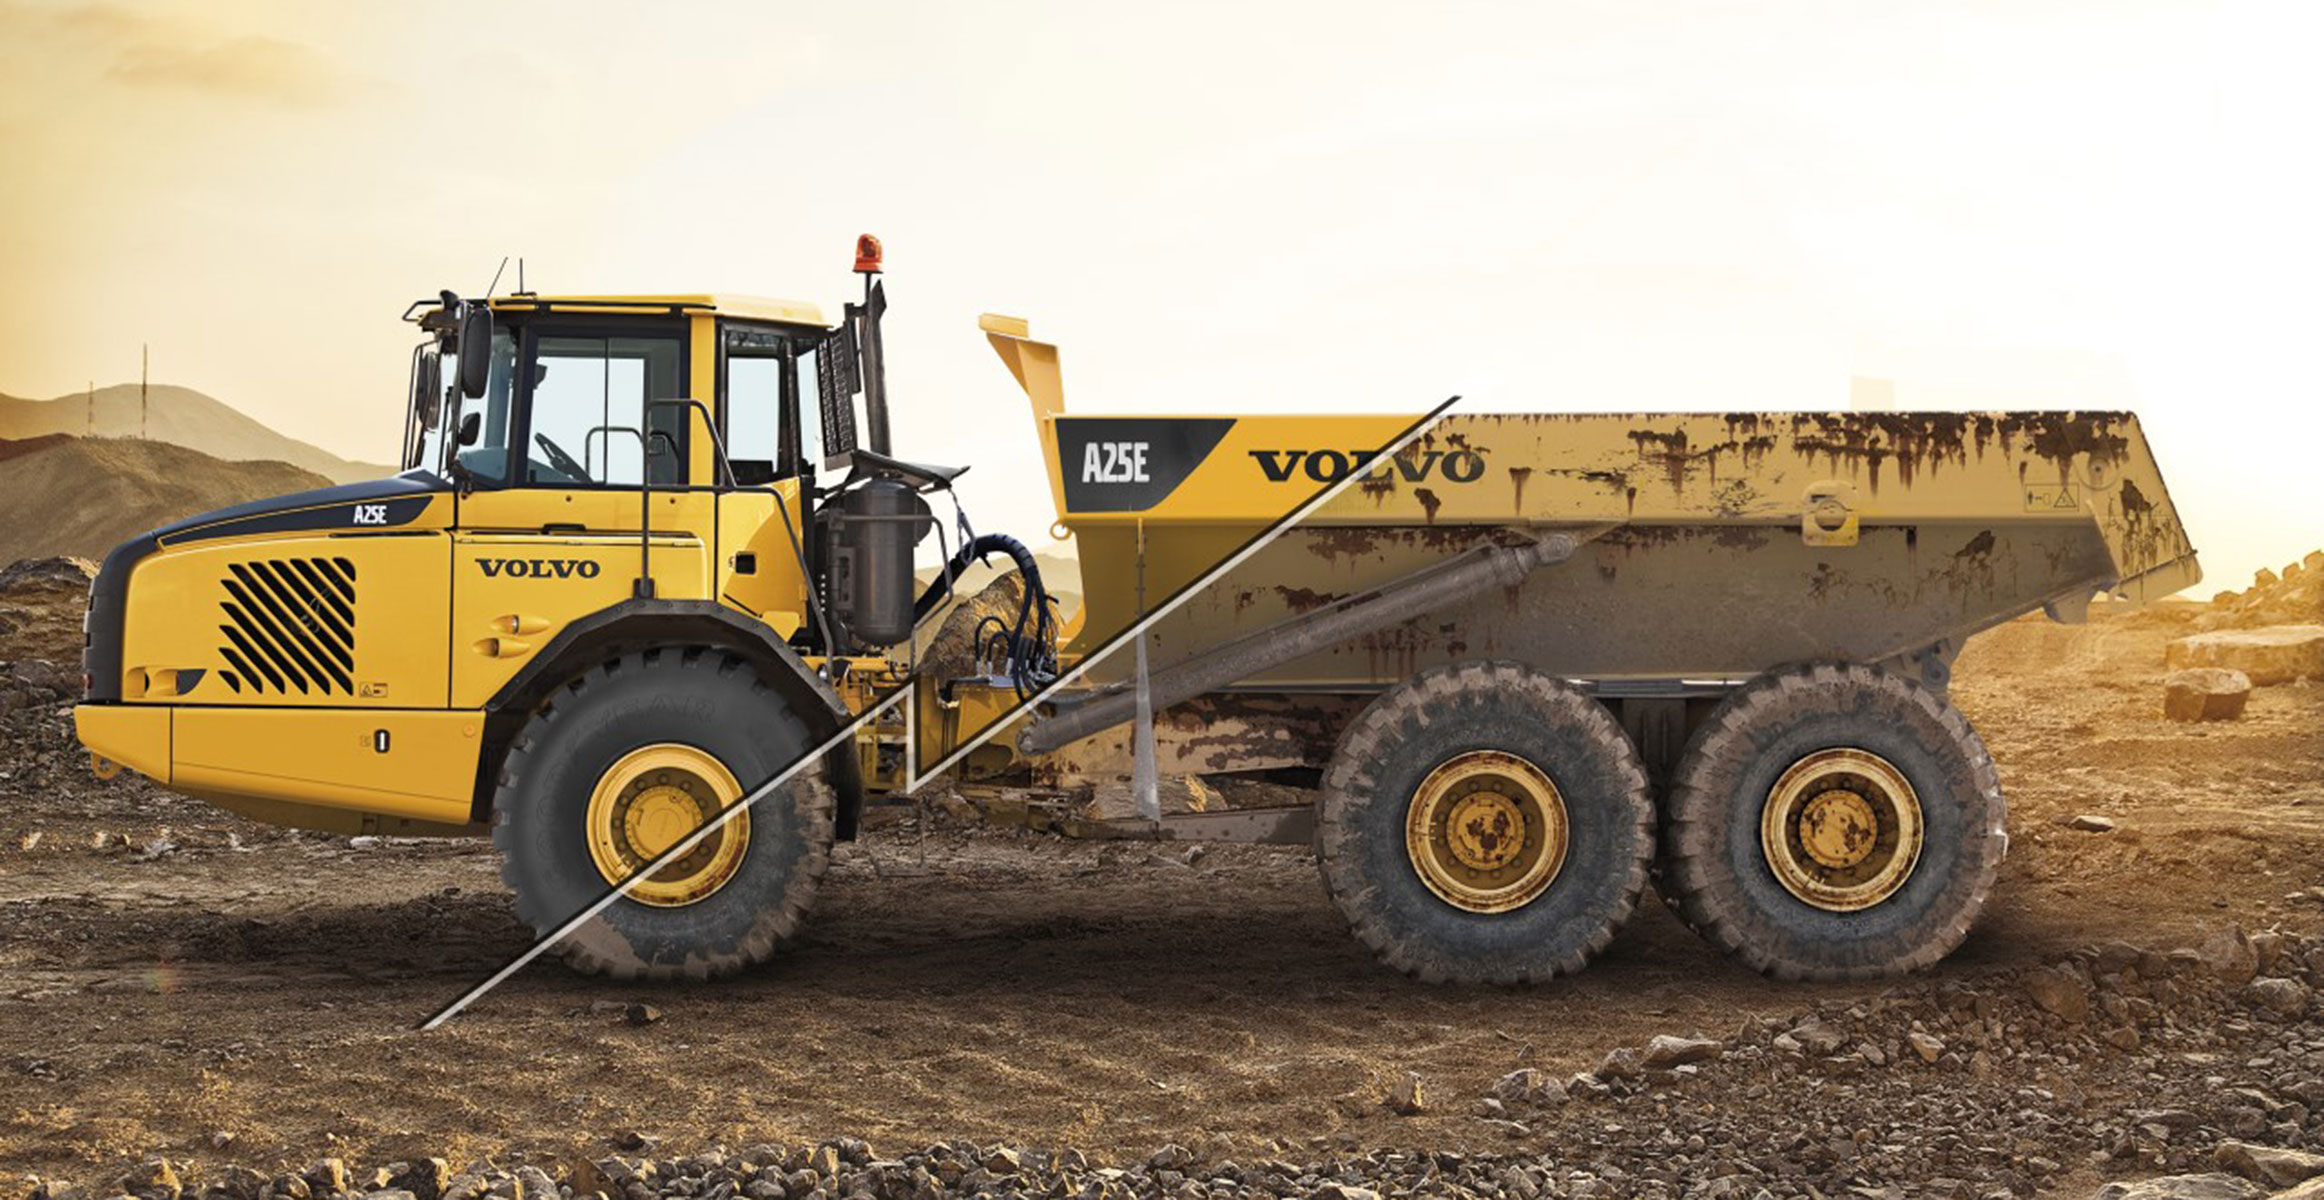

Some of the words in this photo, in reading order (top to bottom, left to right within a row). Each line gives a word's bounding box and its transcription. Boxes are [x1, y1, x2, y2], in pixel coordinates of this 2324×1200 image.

[1081, 441, 1150, 484] A25E
[1248, 449, 1486, 483] VOLVO
[353, 504, 388, 524] A25E
[474, 558, 601, 579] VOLVO
